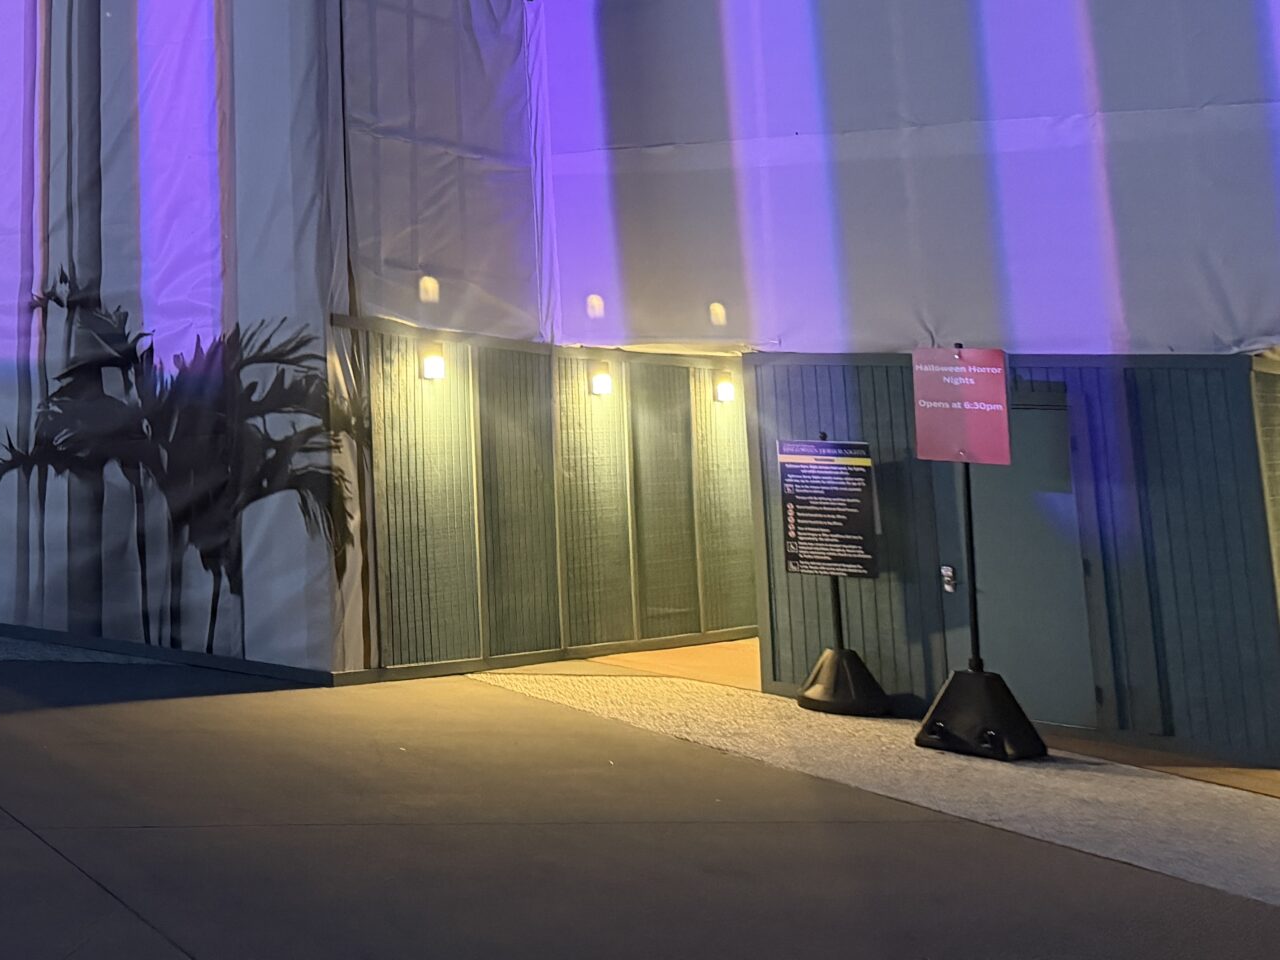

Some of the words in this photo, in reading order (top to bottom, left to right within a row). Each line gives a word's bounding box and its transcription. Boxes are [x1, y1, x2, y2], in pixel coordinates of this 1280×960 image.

[915, 364, 966, 373] Halloween
[968, 365, 1002, 374] Horror
[942, 376, 975, 385] Nights
[918, 400, 949, 409] Opens
[951, 401, 962, 409] at
